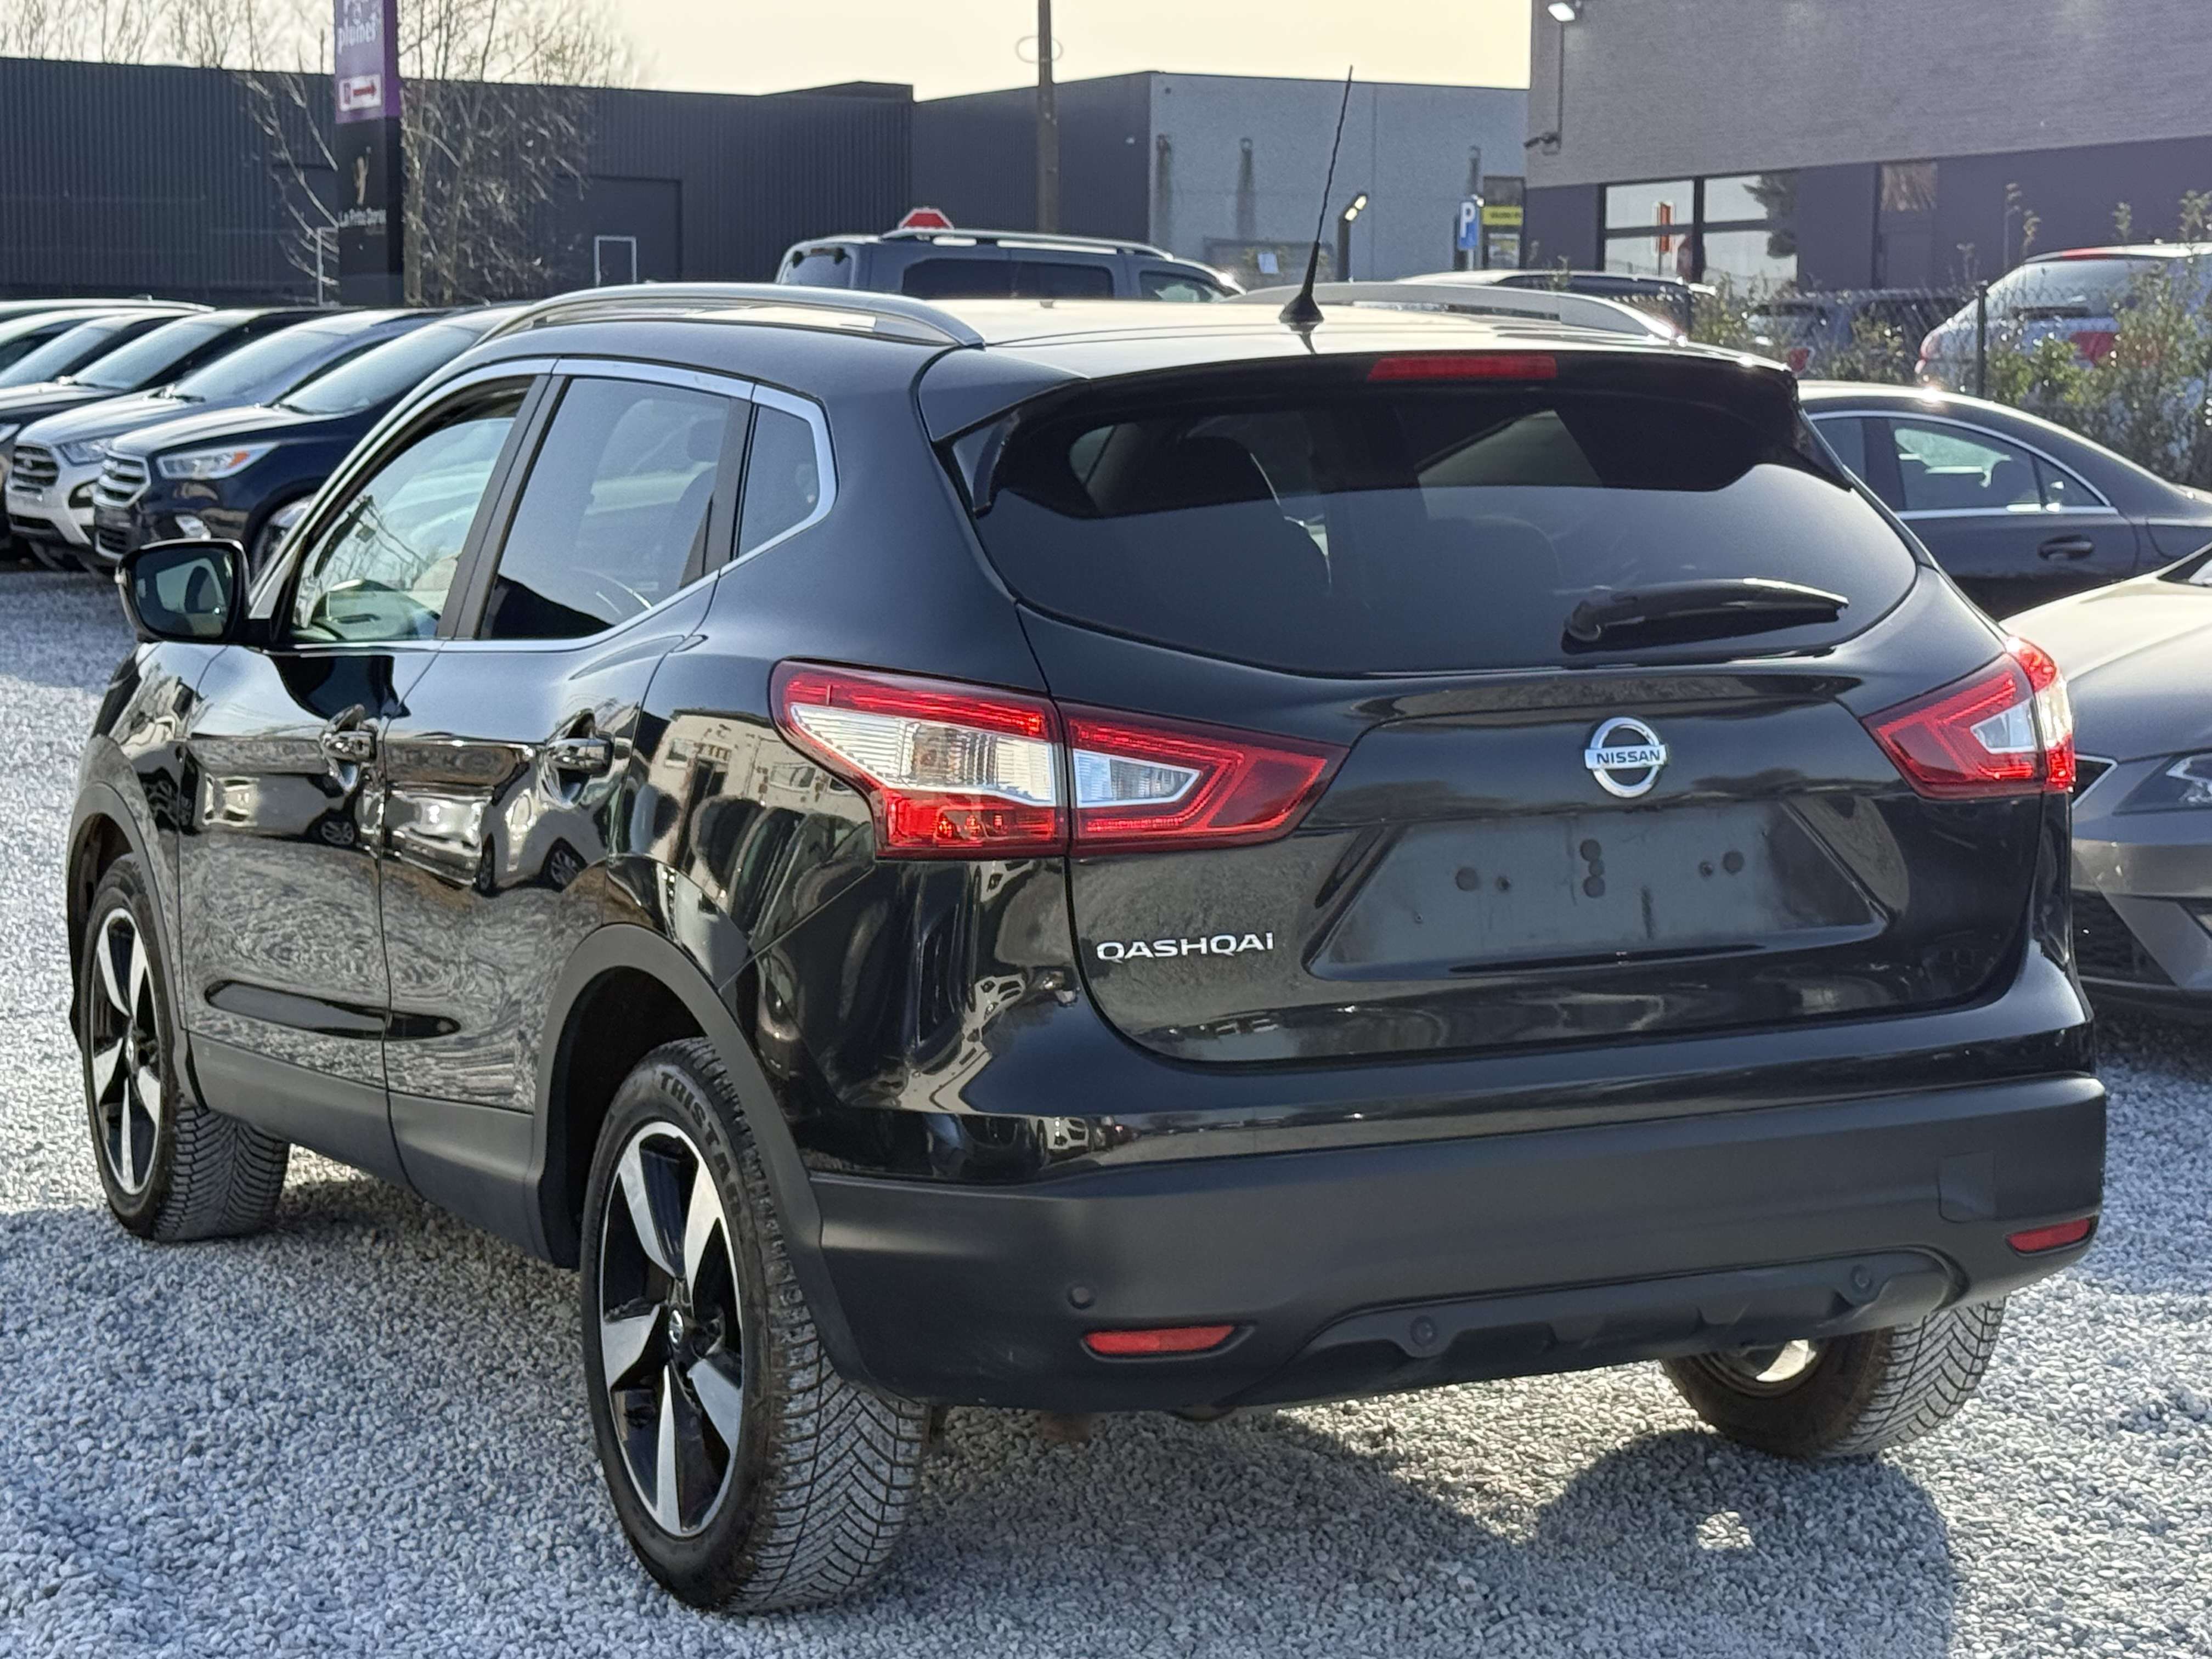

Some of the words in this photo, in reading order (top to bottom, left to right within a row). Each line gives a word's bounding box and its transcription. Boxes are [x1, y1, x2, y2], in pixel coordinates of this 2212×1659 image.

[1459, 201, 1476, 238] P
[1596, 749, 1660, 764] NISSAN
[1097, 932, 1273, 963] QASHQAI
[660, 1071, 741, 1218] TRISTAR
